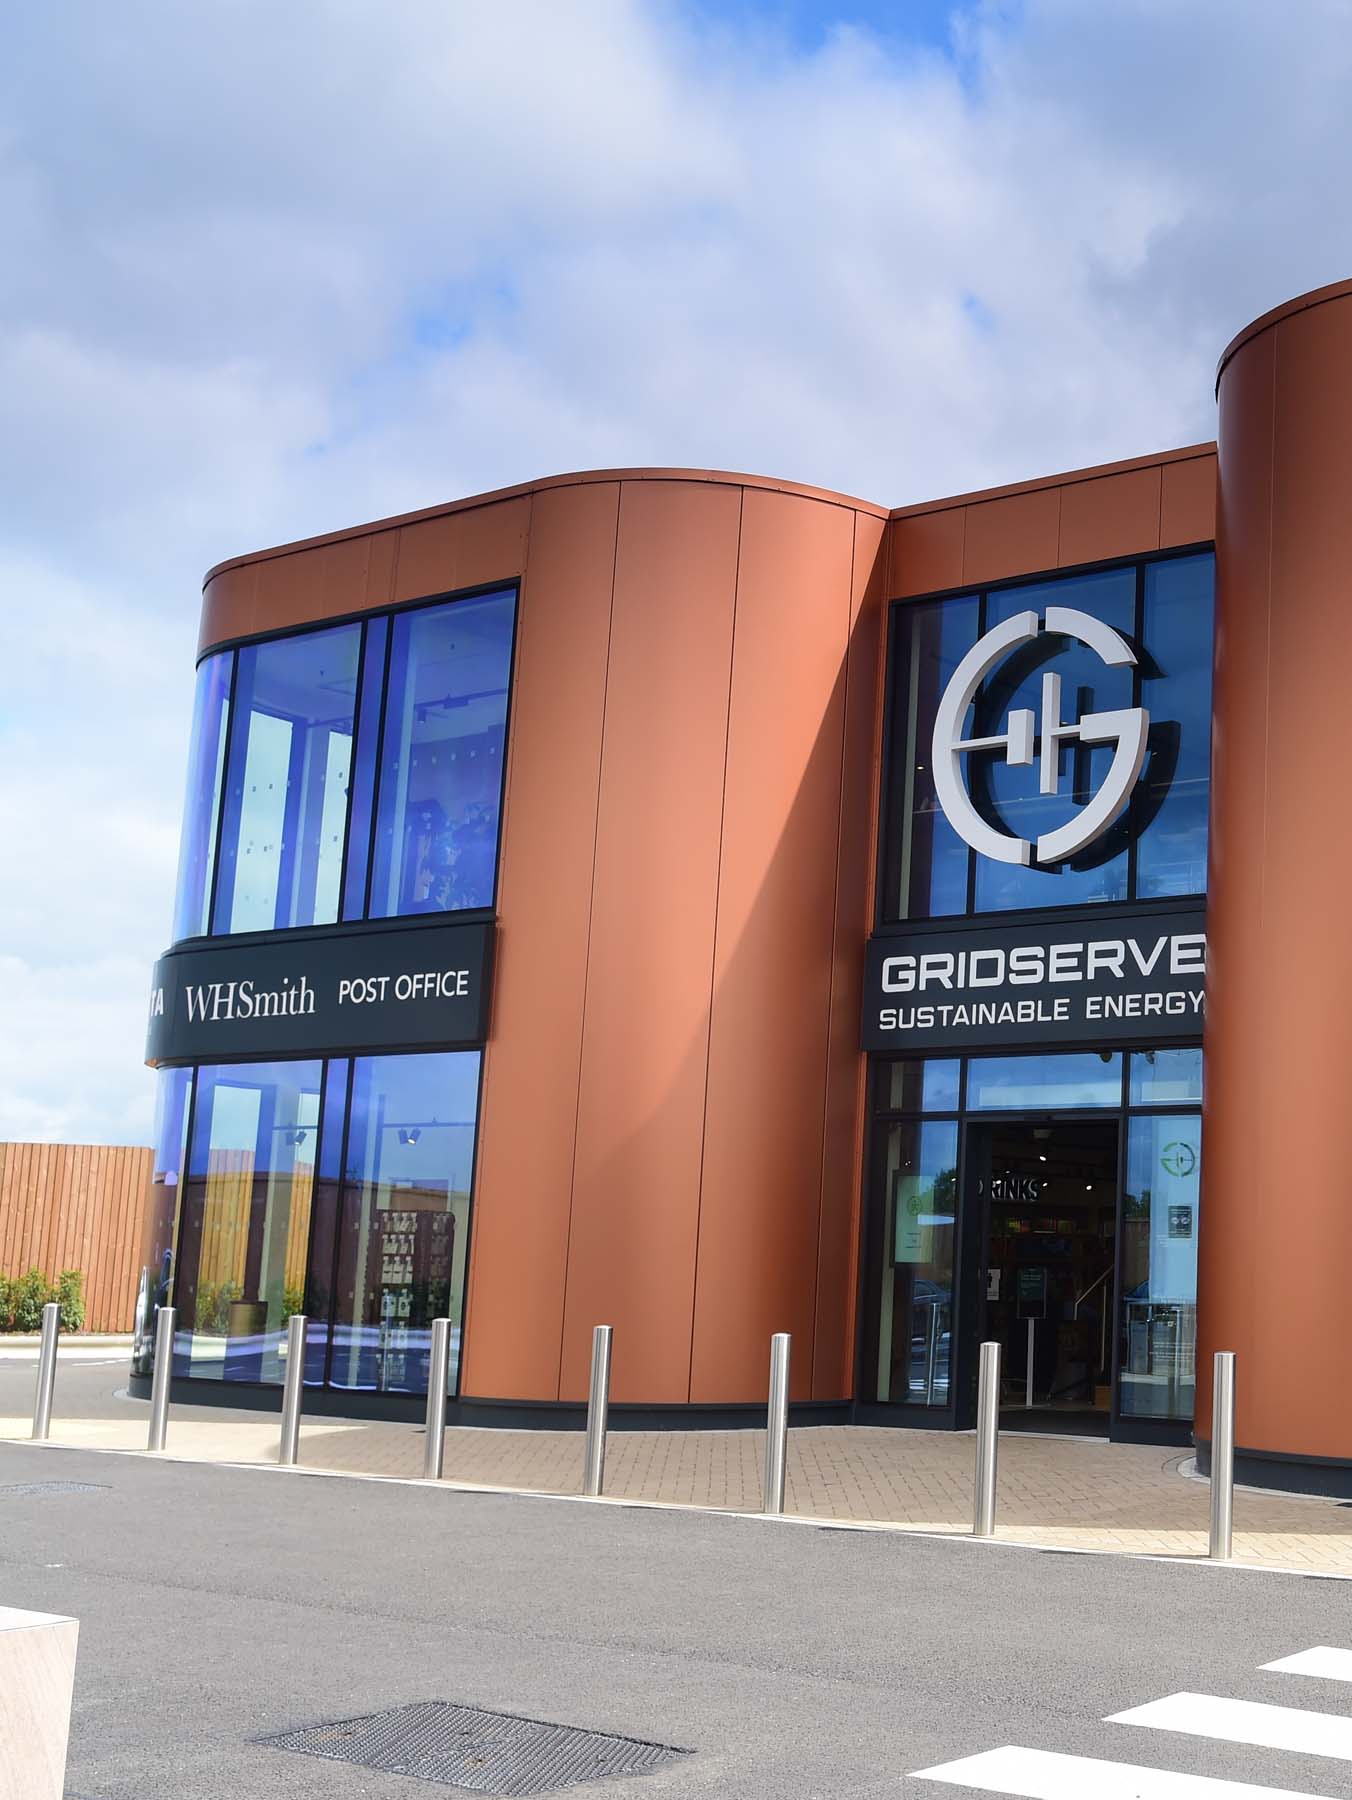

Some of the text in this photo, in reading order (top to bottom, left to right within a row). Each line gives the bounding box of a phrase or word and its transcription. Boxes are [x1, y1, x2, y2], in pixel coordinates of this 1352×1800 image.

[881, 933, 1207, 994] GRIDSERVE
[184, 976, 316, 1023] WHSmith
[338, 977, 390, 1005] POST
[395, 970, 469, 1001] OFFICE
[879, 990, 1205, 1030] SUSTAINABLE ENERGY
